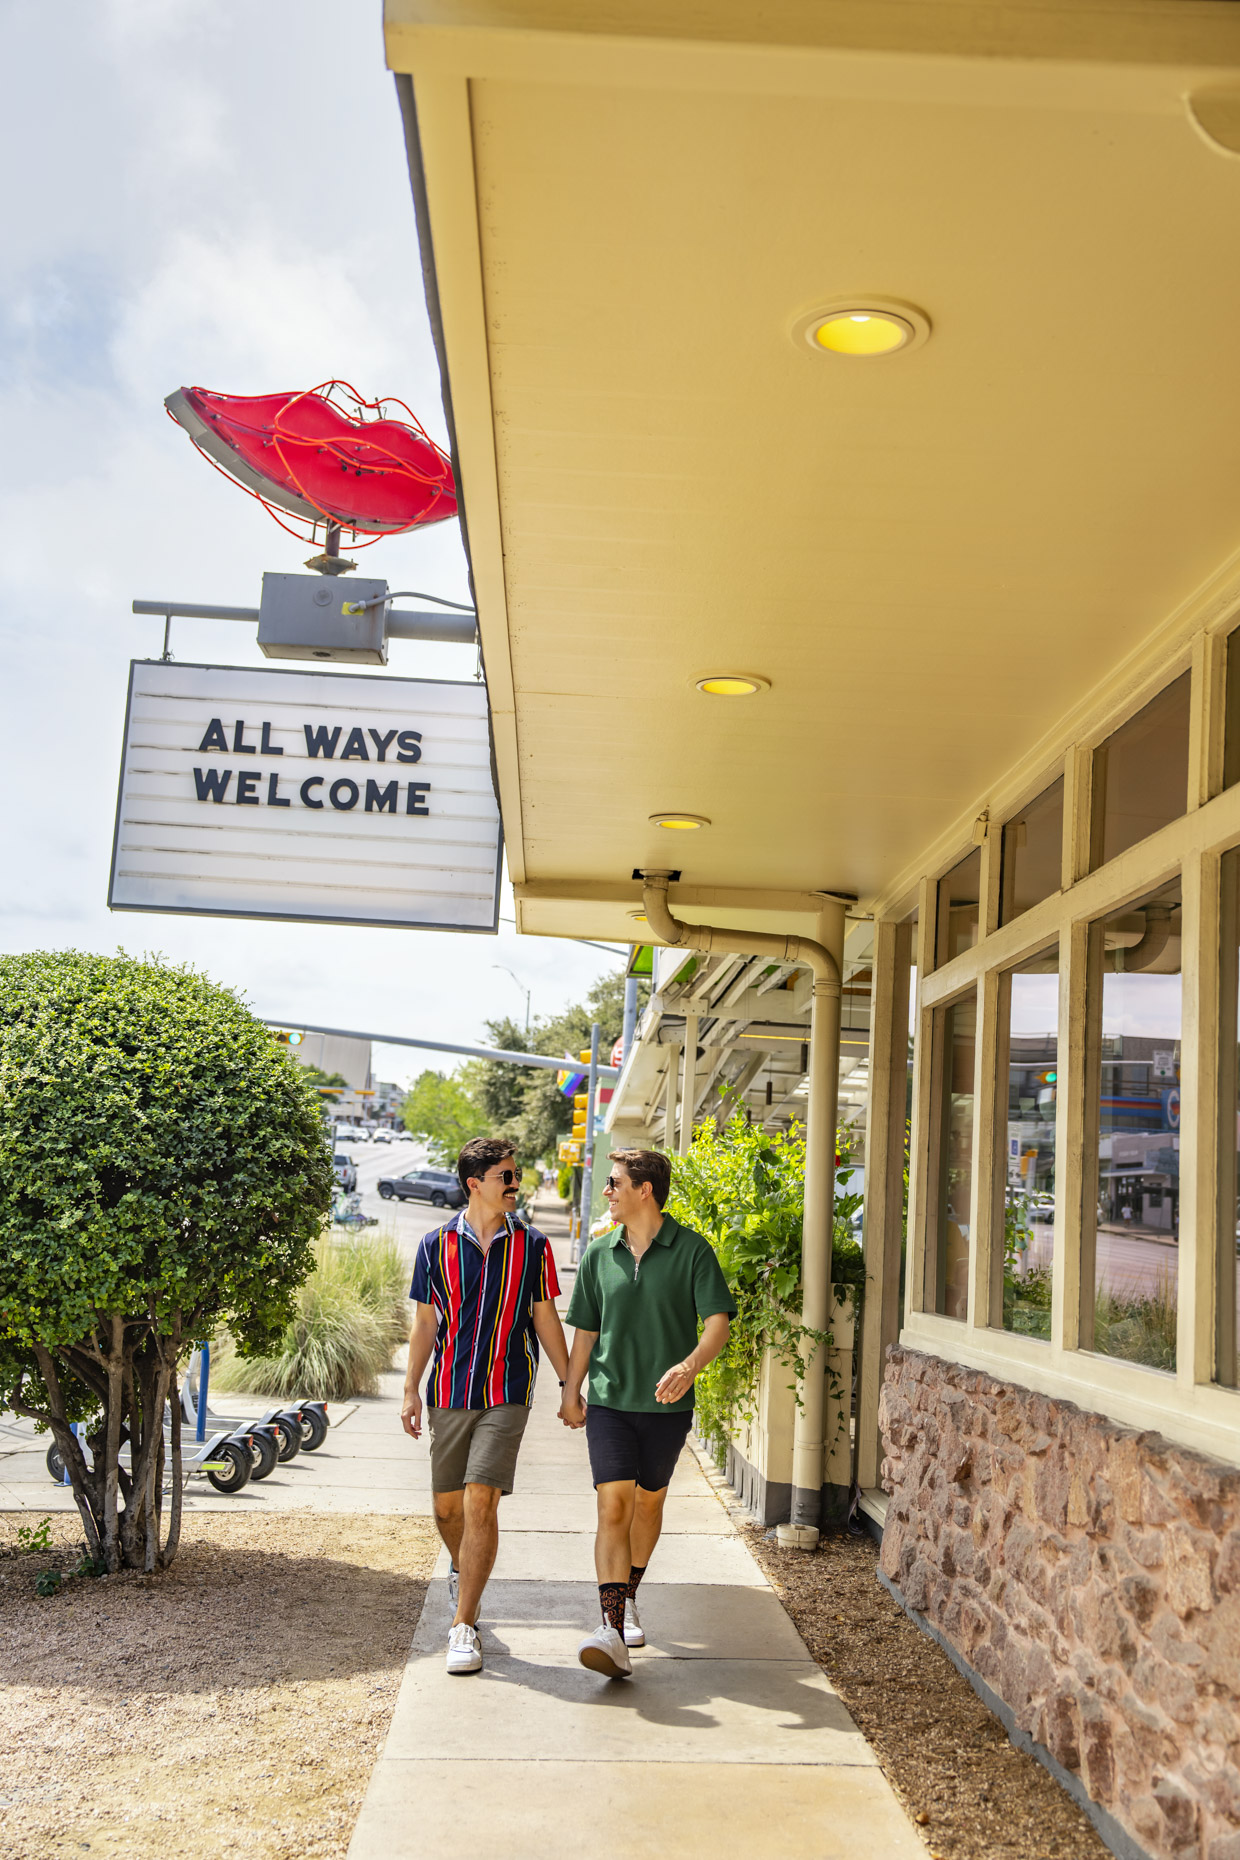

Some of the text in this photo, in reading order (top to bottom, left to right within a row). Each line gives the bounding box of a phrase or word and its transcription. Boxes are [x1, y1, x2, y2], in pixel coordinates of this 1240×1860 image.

[198, 718, 423, 764] ALL WAYS
[193, 767, 431, 816] WELCOME
